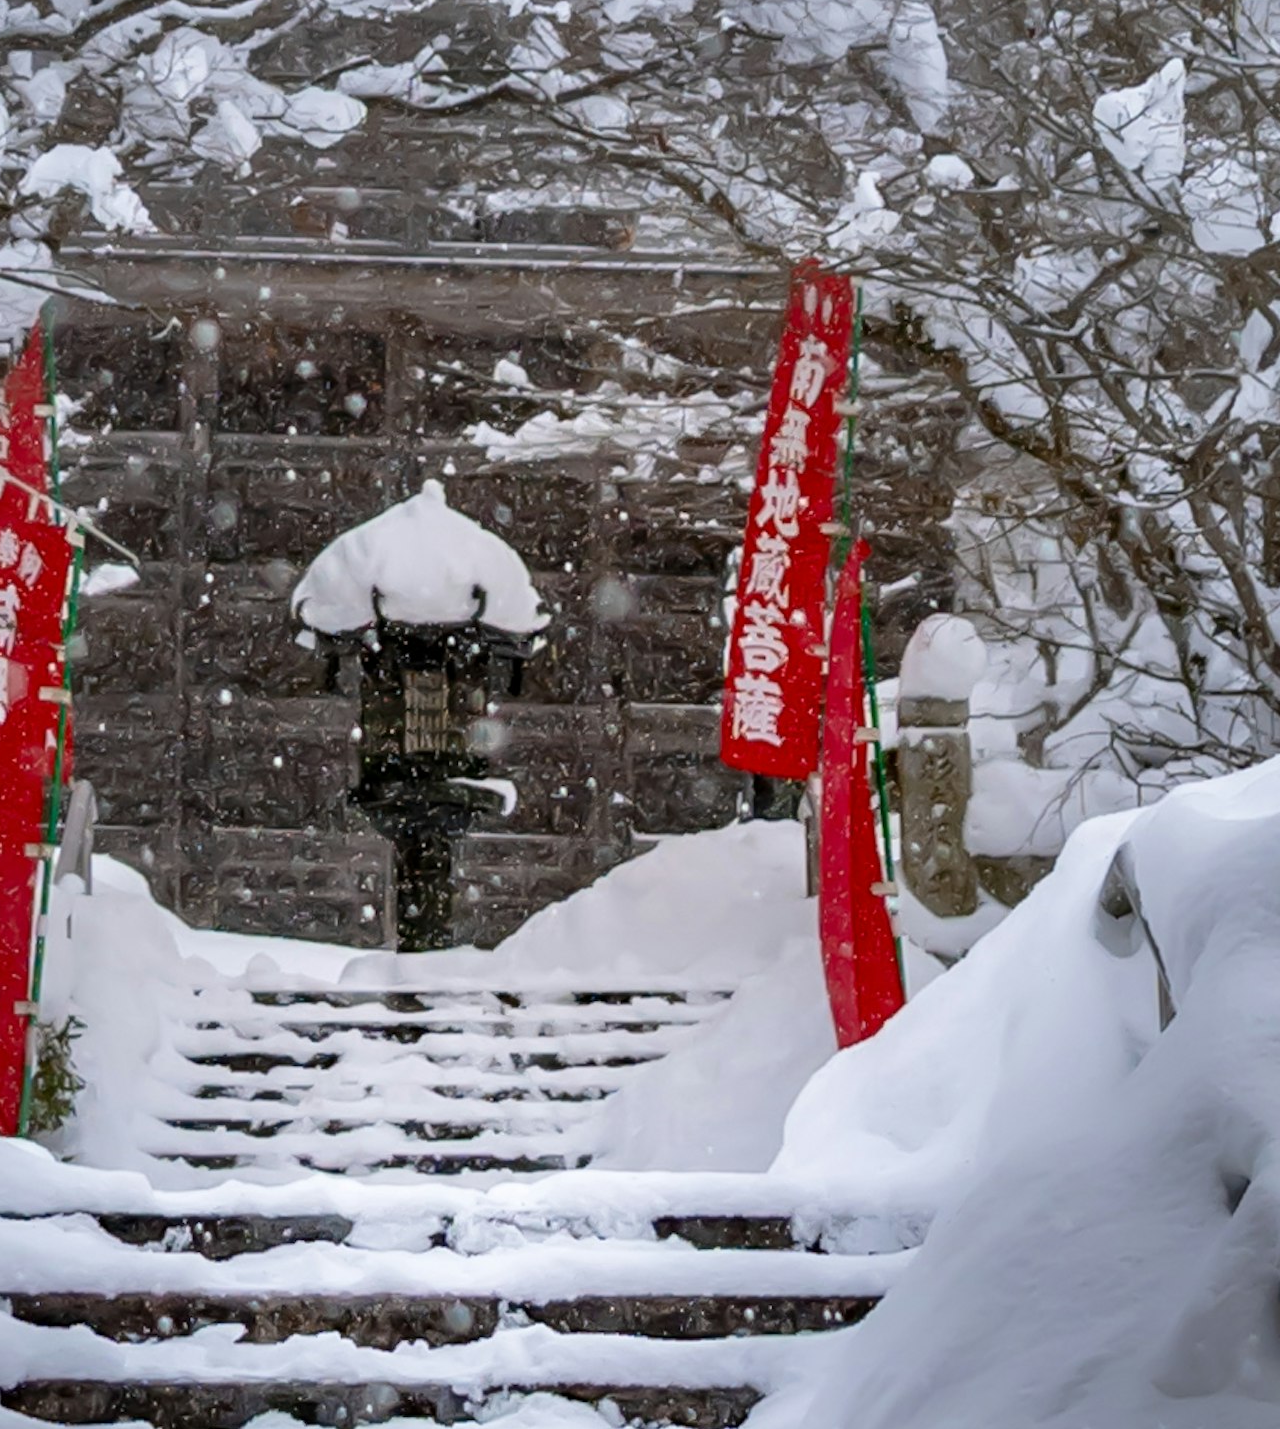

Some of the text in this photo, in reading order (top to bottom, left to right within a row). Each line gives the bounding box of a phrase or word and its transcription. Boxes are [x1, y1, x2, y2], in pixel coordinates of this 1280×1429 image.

[732, 334, 827, 747] 南無地蔵菩薩
